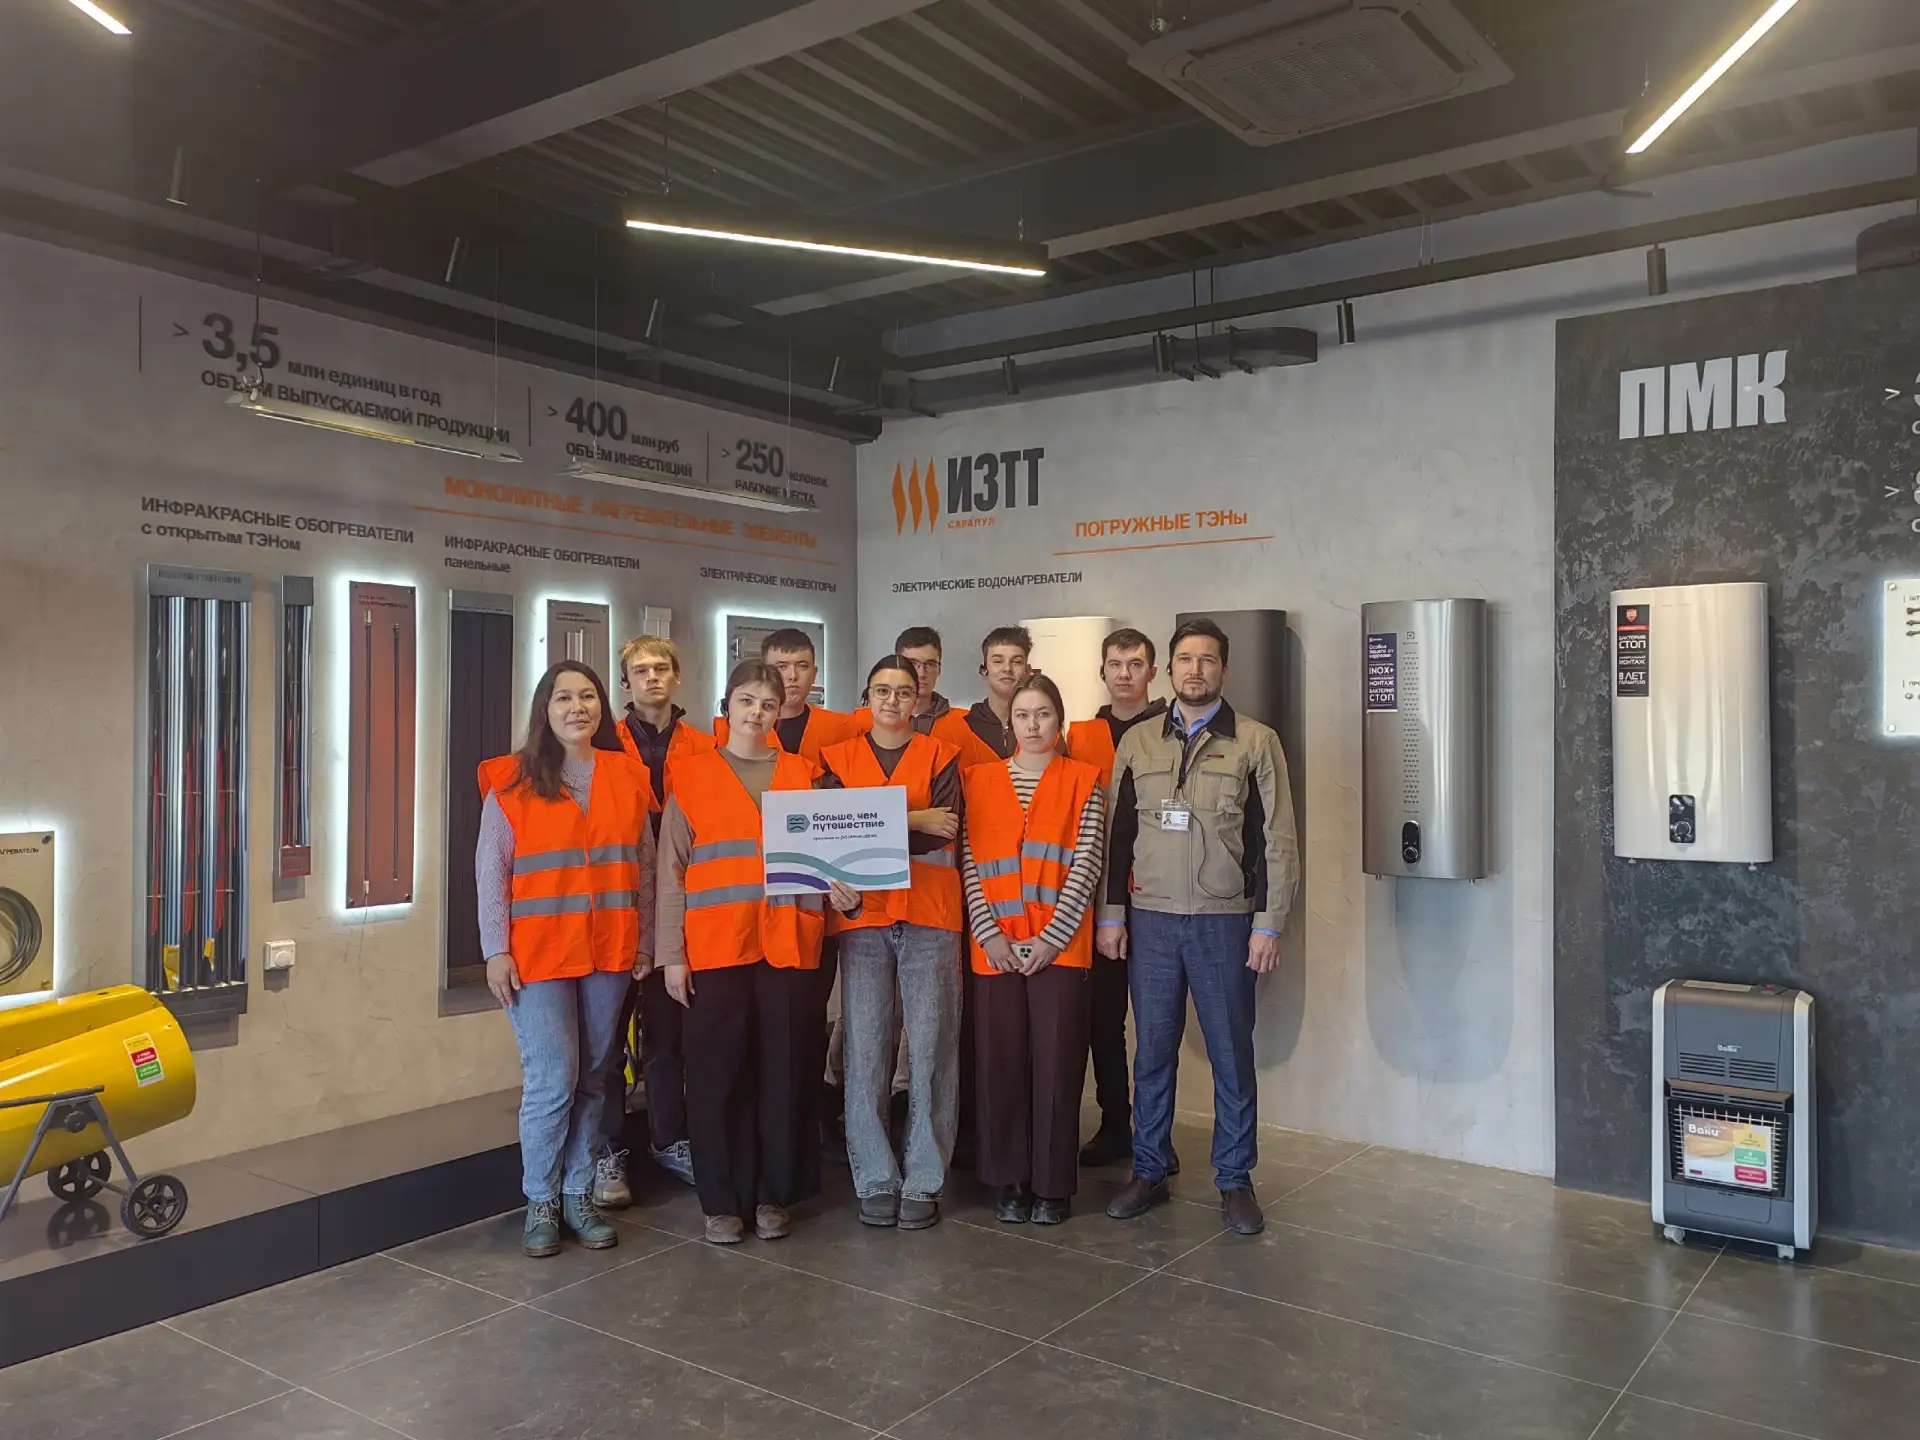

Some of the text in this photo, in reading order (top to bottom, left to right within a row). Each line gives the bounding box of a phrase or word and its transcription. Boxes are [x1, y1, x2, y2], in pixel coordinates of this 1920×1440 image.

[202, 312, 281, 373] 3,5
[287, 360, 326, 381] млн
[328, 369, 397, 399] единиц
[400, 384, 410, 398] в
[412, 387, 442, 408] год
[201, 369, 511, 444] ОБЪМ ВЫПУСКАЕМОЙ ПРОДУКЦИИ
[1618, 349, 1789, 440] ПМК
[565, 396, 628, 442] 400
[658, 438, 680, 455] руб
[614, 451, 693, 478] ИНВЕСТИЦИЙ
[735, 437, 785, 478] 250
[735, 479, 782, 498] РАБОЧИЕ
[947, 446, 1045, 514] ИЗТТ
[140, 496, 415, 544] ИНФРАКРАСНЫЕ ОБОГРЕВАТЕЛИ
[443, 475, 583, 515] МОНОЛИТНЫЕ
[592, 500, 735, 537] НАГРЕВАТЕЛЬНЫЕ
[140, 522, 301, 552] с открытым ТЭНом
[947, 516, 996, 530] САРАПУЛ
[1074, 508, 1248, 538] ПОГРУЖНЫЕ ТЭНы
[444, 534, 641, 571] ИНФРАКРАСНЫЕ ОБОГРЕВАТЕЛИ
[444, 556, 512, 574] панельные
[699, 566, 837, 594] ЭЛЕКТРИЧЕСКИЕ КОНВЕКТОРЫ
[891, 570, 1083, 594] ЭЛЕКТРИЧЕСКИЕ ВОДОНАГРЕВАТЕЛИ
[1618, 640, 1646, 648] СТОП
[1625, 672, 1646, 680] ЛЕТ
[1369, 694, 1394, 702] СТОП
[812, 811, 878, 822] больше, чем
[812, 820, 885, 832] путешествие
